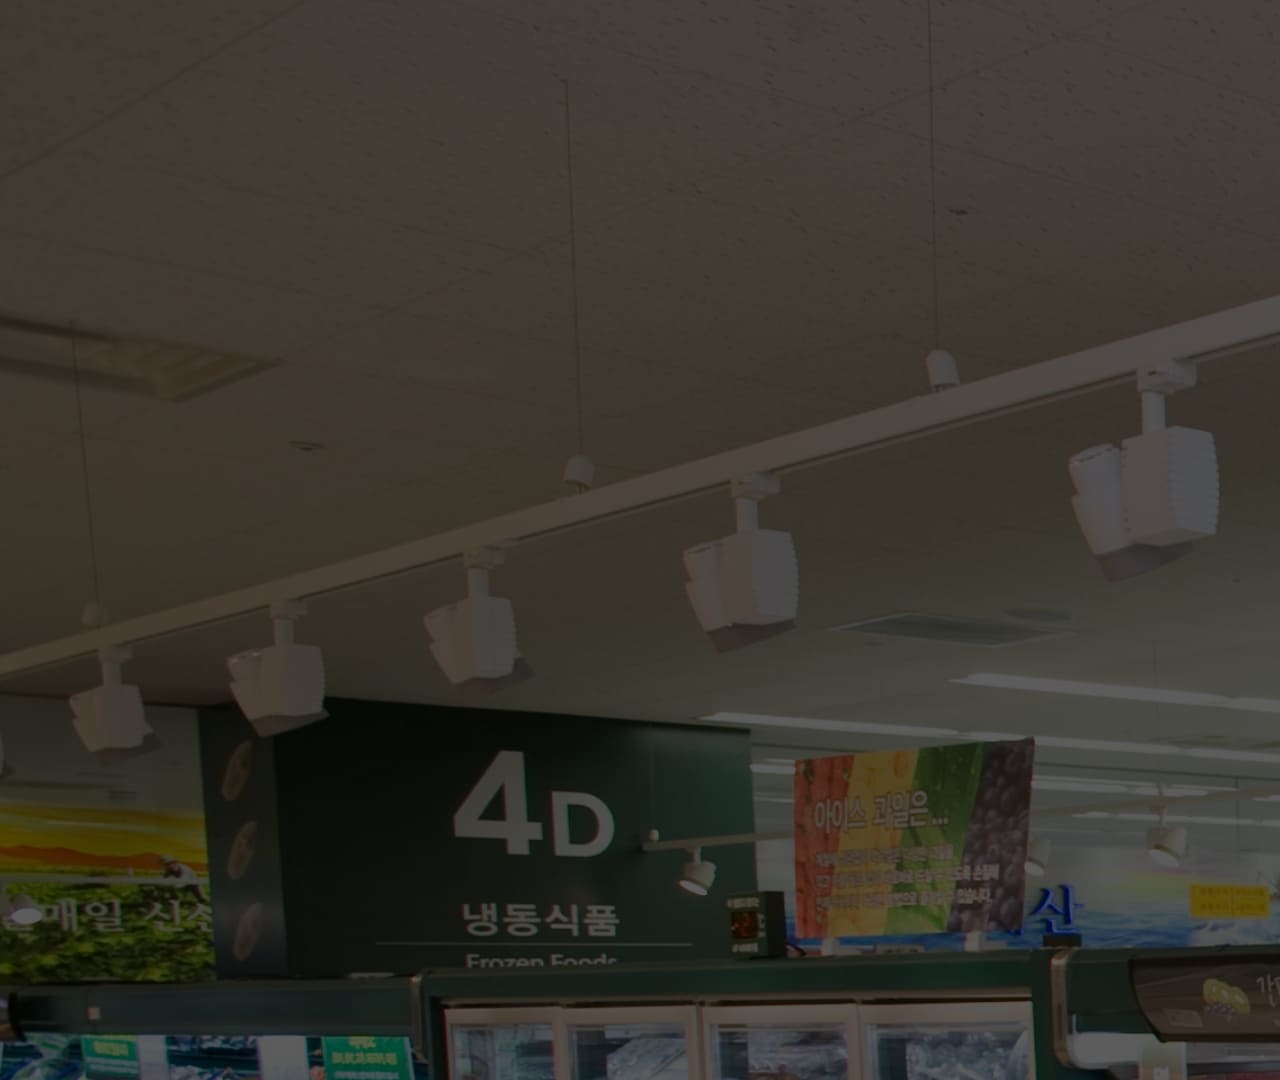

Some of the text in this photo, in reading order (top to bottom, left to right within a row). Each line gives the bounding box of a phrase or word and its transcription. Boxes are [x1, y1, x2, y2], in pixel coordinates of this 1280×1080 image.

[453, 750, 616, 858] 4D
[814, 798, 866, 833] 아이스
[461, 902, 621, 937] 냉동식품
